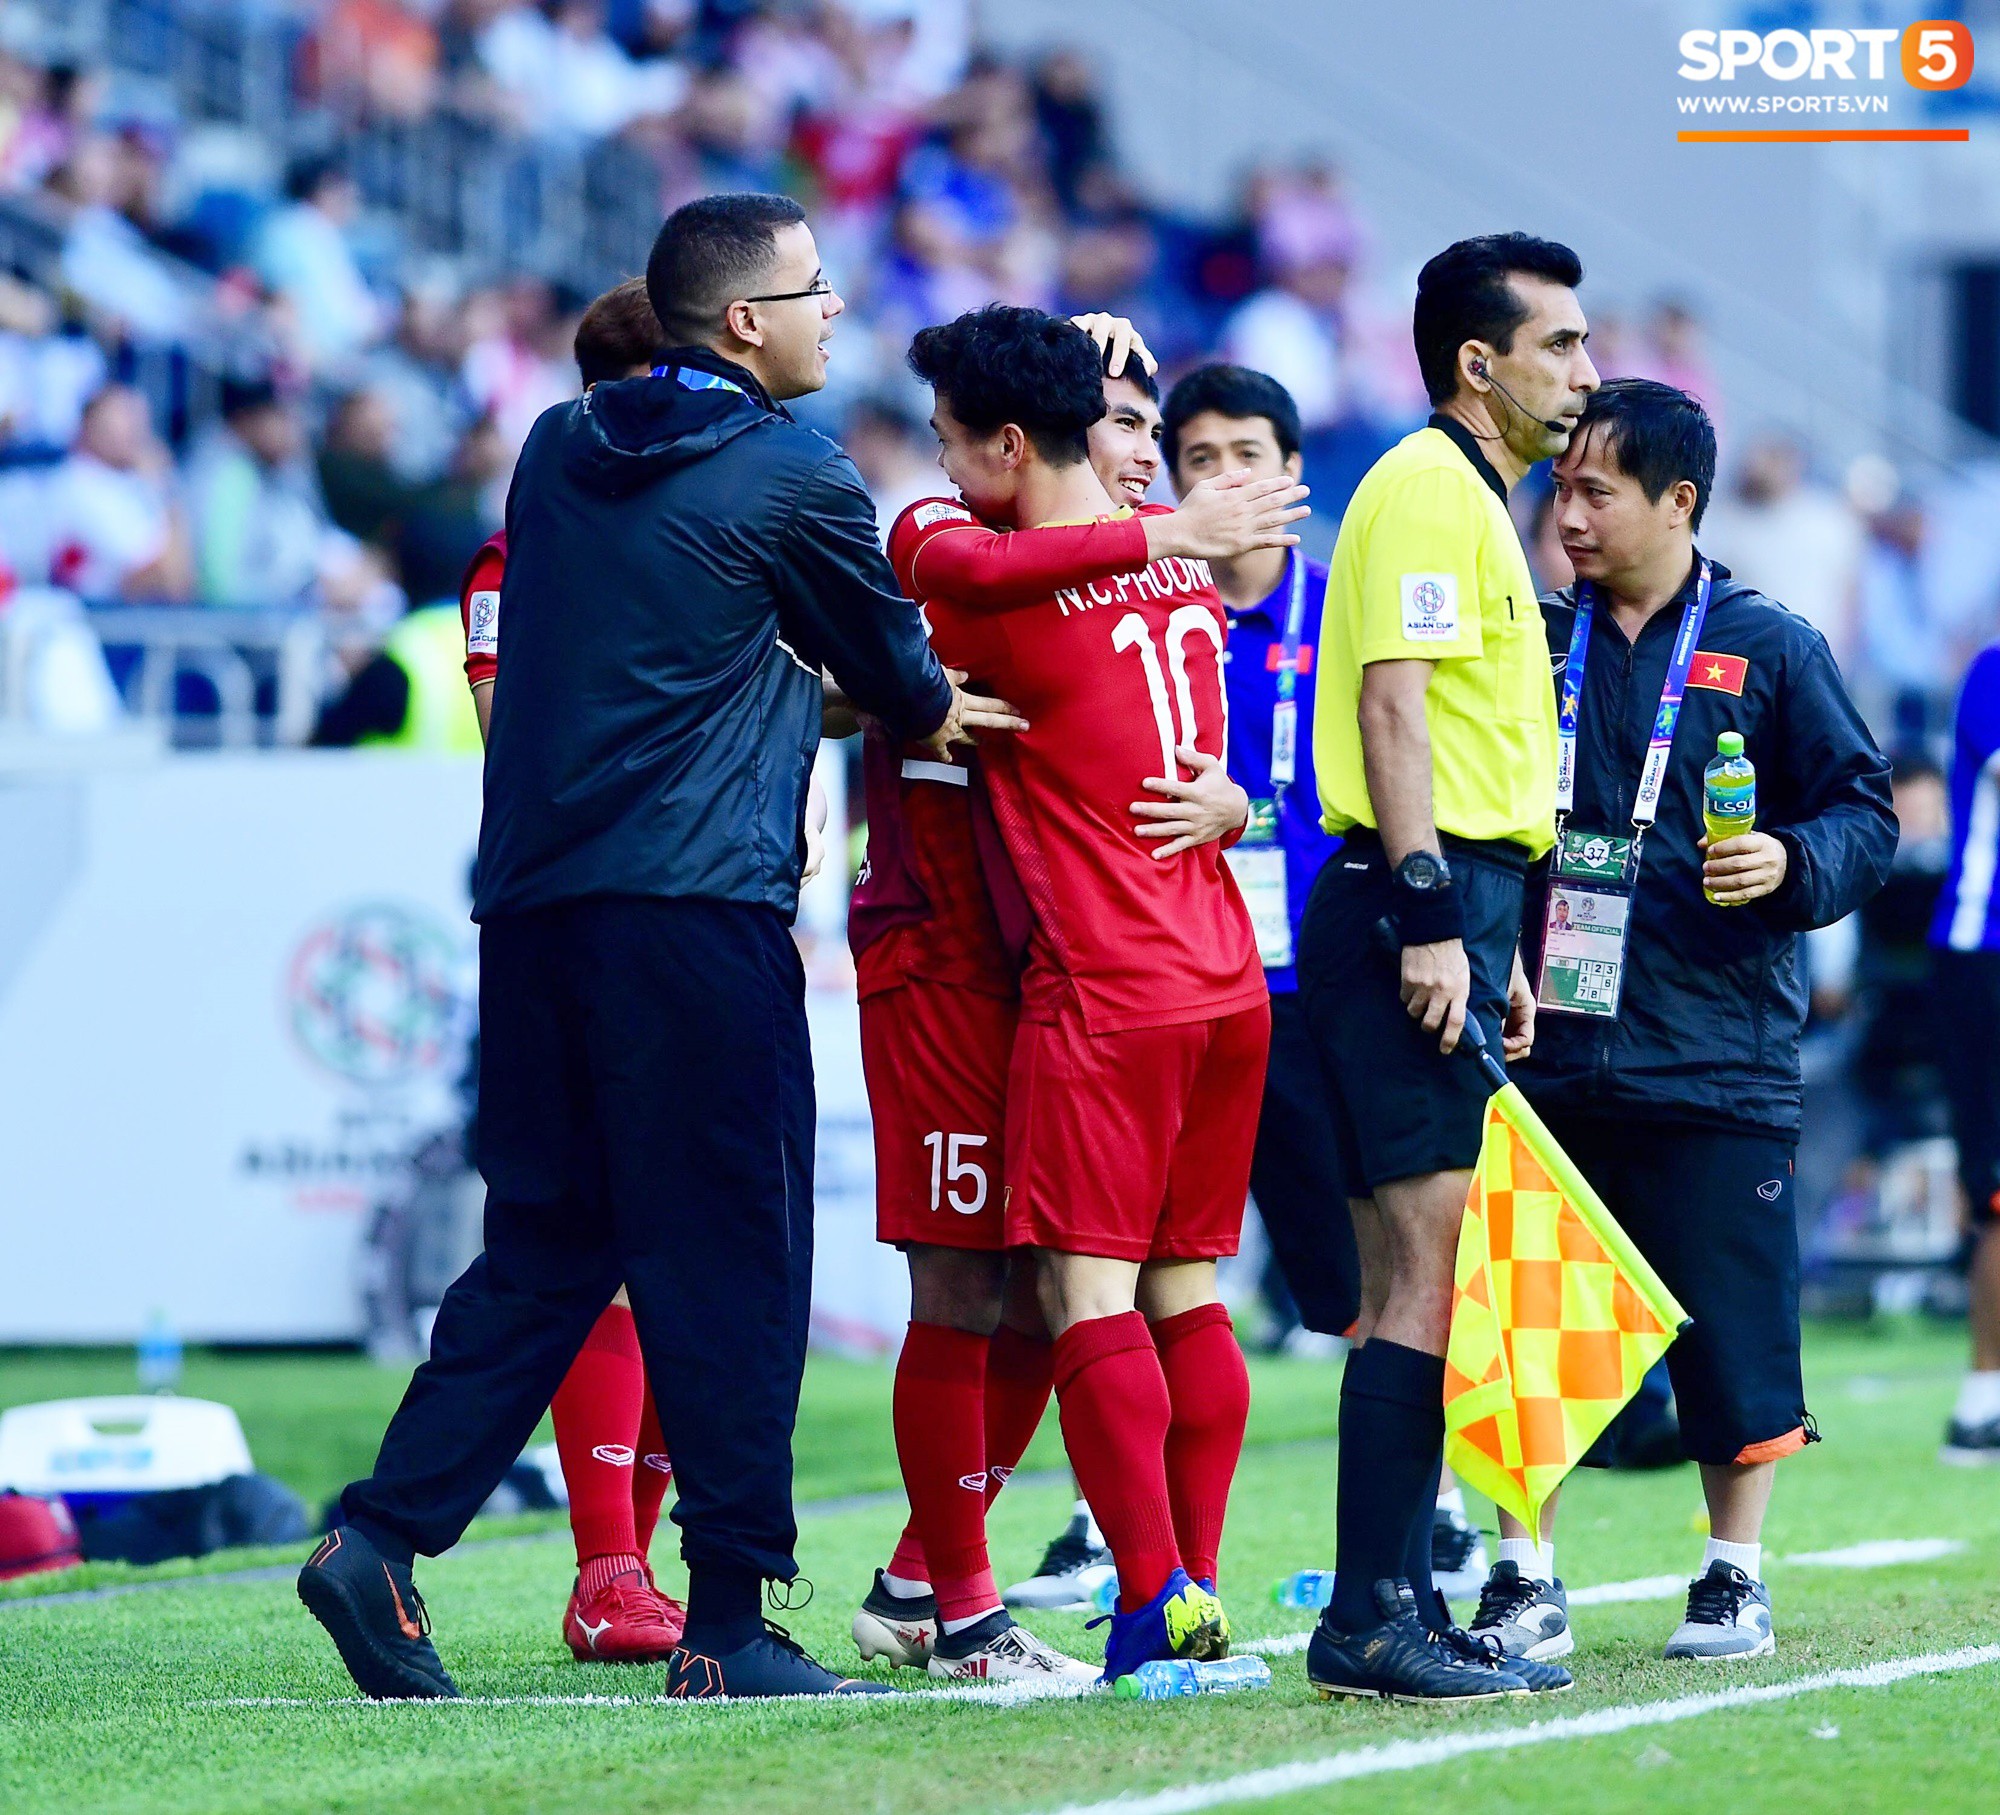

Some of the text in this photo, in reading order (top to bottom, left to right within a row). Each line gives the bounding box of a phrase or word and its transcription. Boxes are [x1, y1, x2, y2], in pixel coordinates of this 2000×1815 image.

[1111, 604, 1229, 798] 10
[1588, 847, 1605, 861] 37
[1573, 923, 1620, 935] TEAM OFFICIAL
[1595, 964, 1601, 973] 2
[1607, 966, 1613, 974] 3
[1580, 989, 1597, 998] 7 8
[924, 1131, 987, 1214] 15
